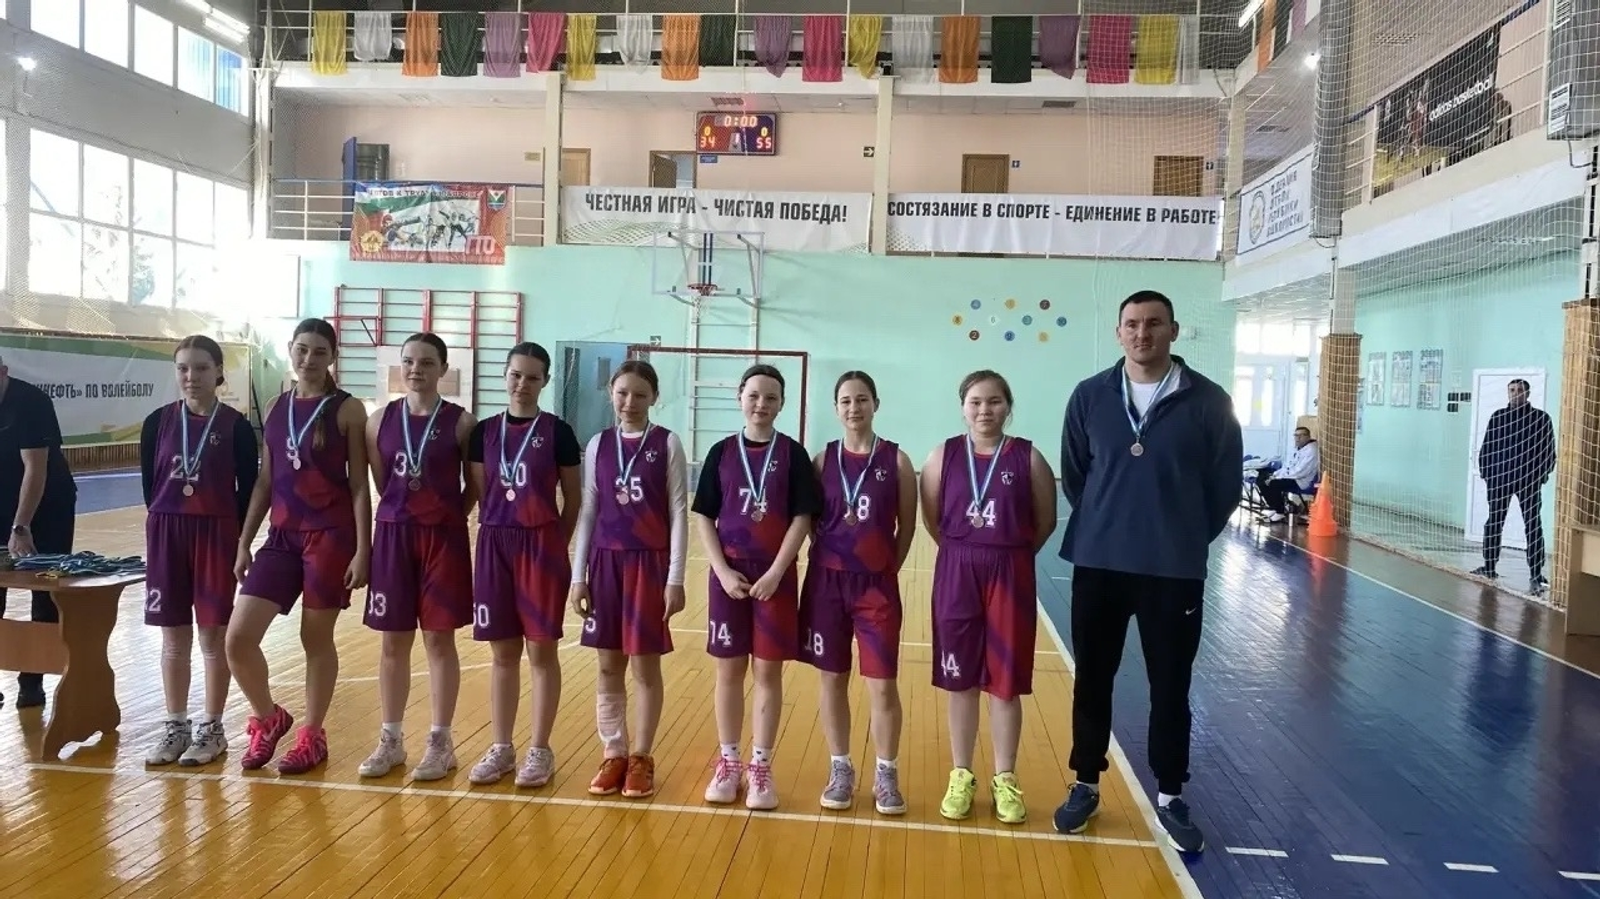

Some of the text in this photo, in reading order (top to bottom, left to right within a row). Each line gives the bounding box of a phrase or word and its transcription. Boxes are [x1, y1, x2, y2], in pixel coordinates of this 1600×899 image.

[724, 116, 757, 127] 0:00
[704, 126, 711, 136] 0
[761, 127, 768, 137] 0
[700, 136, 716, 148] 34
[756, 137, 772, 149] 55
[585, 193, 652, 213] ЧЕСТНАЯ
[658, 195, 697, 214] ИГРА
[714, 198, 775, 219] ЧИСТАЯ
[779, 202, 847, 225] ПОБЕДА!
[887, 201, 978, 217] СОСТЯЗАНИЕ
[982, 203, 992, 217] В
[997, 203, 1050, 219] СПОРТЕ
[1065, 205, 1141, 223] ЕДИНЕНИЕ
[1146, 207, 1156, 222] В
[466, 235, 498, 257] ГТО
[36, 380, 154, 399] НЕФТЬ» ПО ВОЛЕЙБОЛУ
